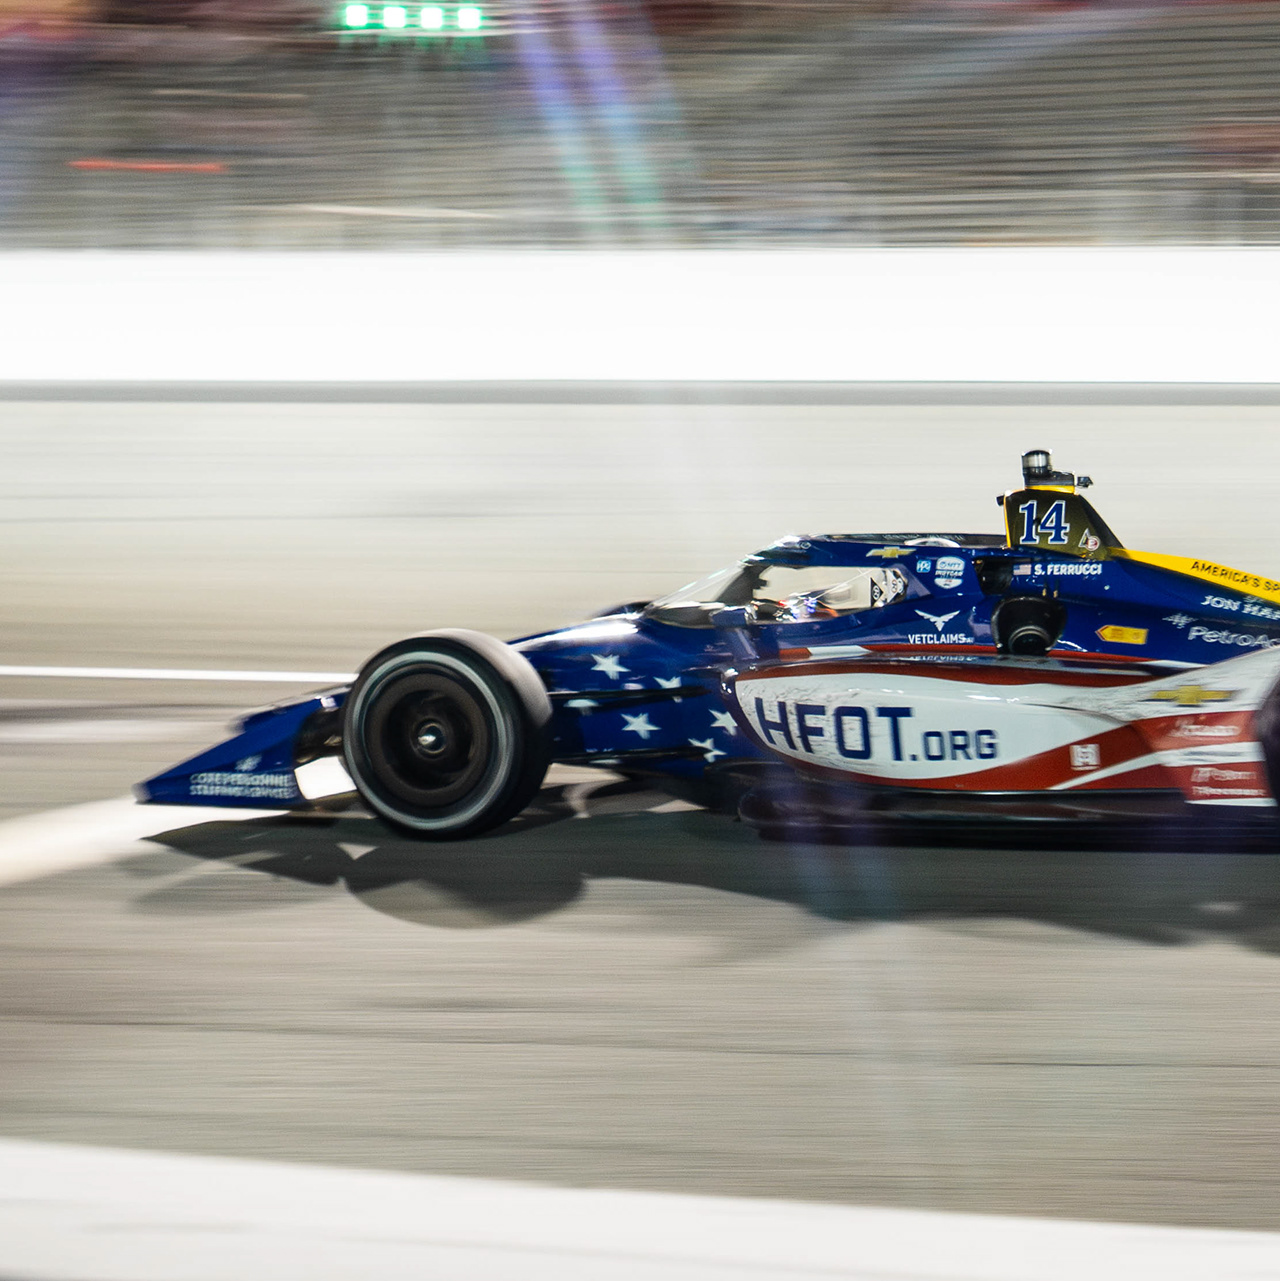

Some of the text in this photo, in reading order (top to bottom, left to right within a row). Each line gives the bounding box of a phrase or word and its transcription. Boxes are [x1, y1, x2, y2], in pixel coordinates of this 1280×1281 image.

[1019, 500, 1070, 544] 14
[1034, 563, 1102, 575] S. FERRUCCI
[1191, 561, 1260, 587] AMERICA'S
[1201, 595, 1241, 611] JON
